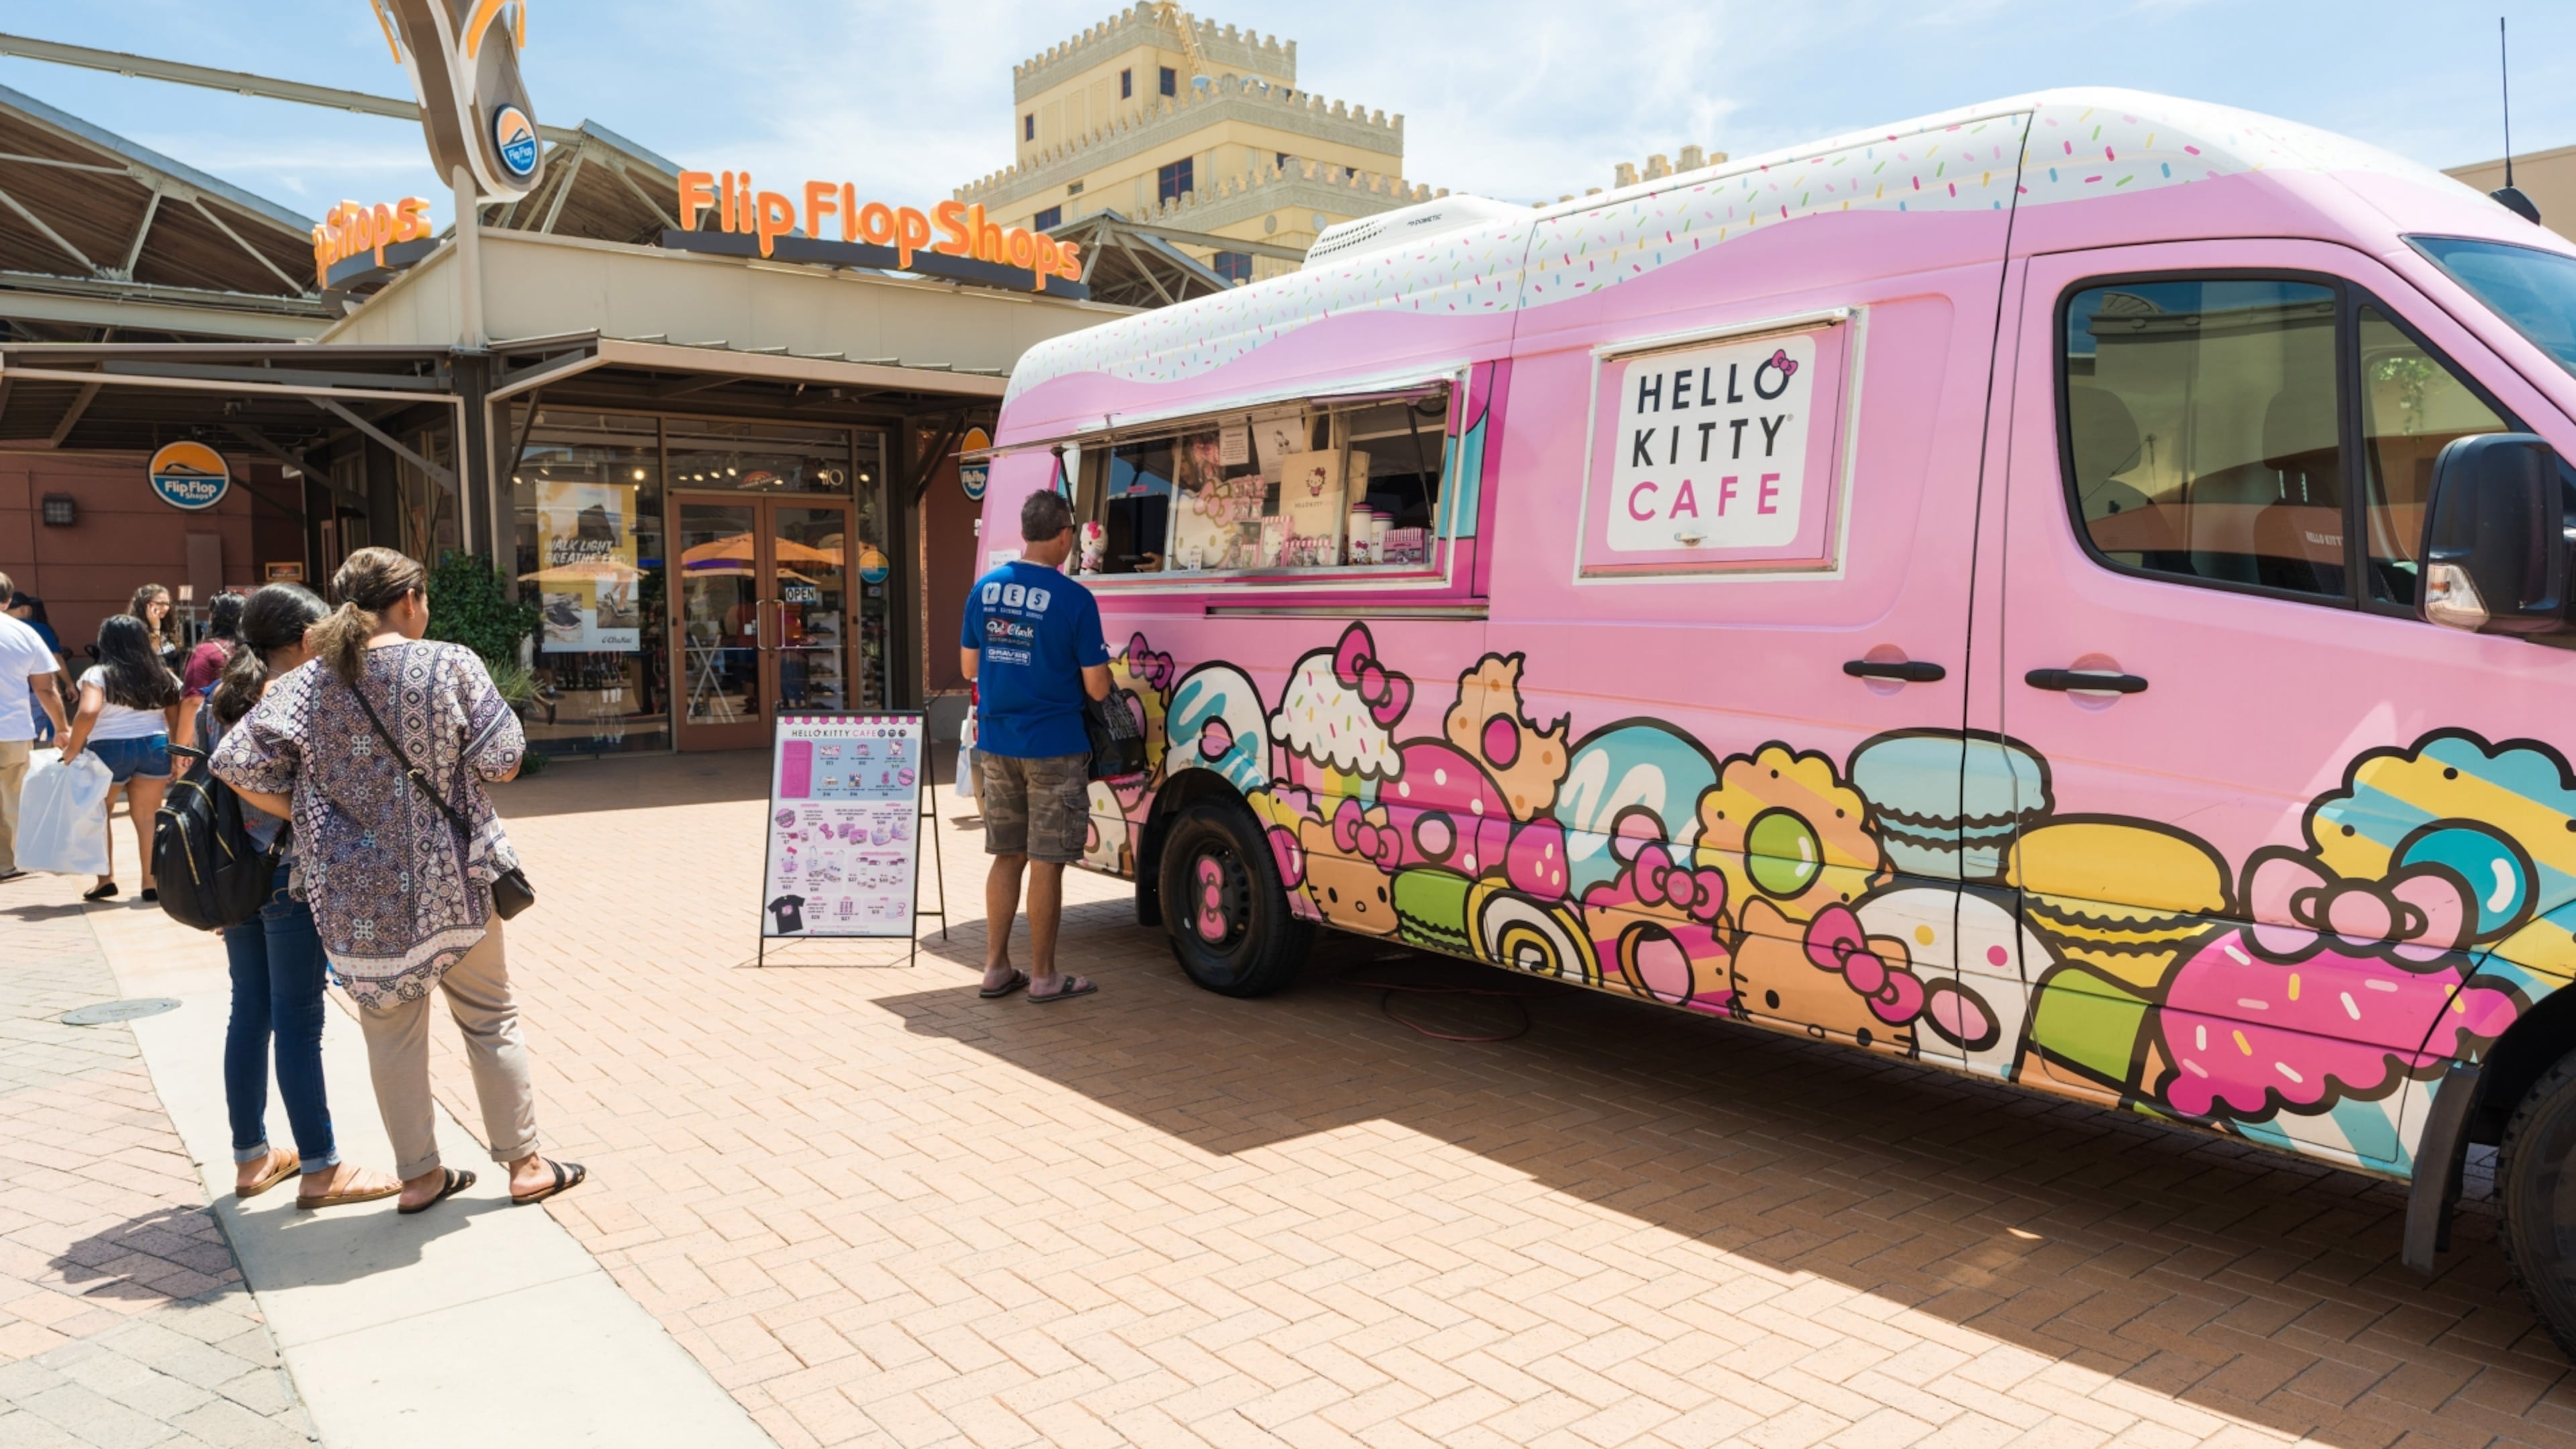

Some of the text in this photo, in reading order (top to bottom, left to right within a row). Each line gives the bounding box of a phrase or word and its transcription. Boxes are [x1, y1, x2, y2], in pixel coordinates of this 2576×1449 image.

[678, 170, 1083, 292] Flip Flop Shops
[1636, 350, 1792, 414] HELLO
[164, 480, 217, 498] Flip Flop
[1627, 473, 1781, 522] CAFE
[543, 539, 578, 551] WALK
[544, 552, 596, 564] BREATHE
[786, 588, 814, 600] OPEN
[985, 585, 1044, 606] YES
[792, 729, 876, 737] HELLO KITTY CAFE
